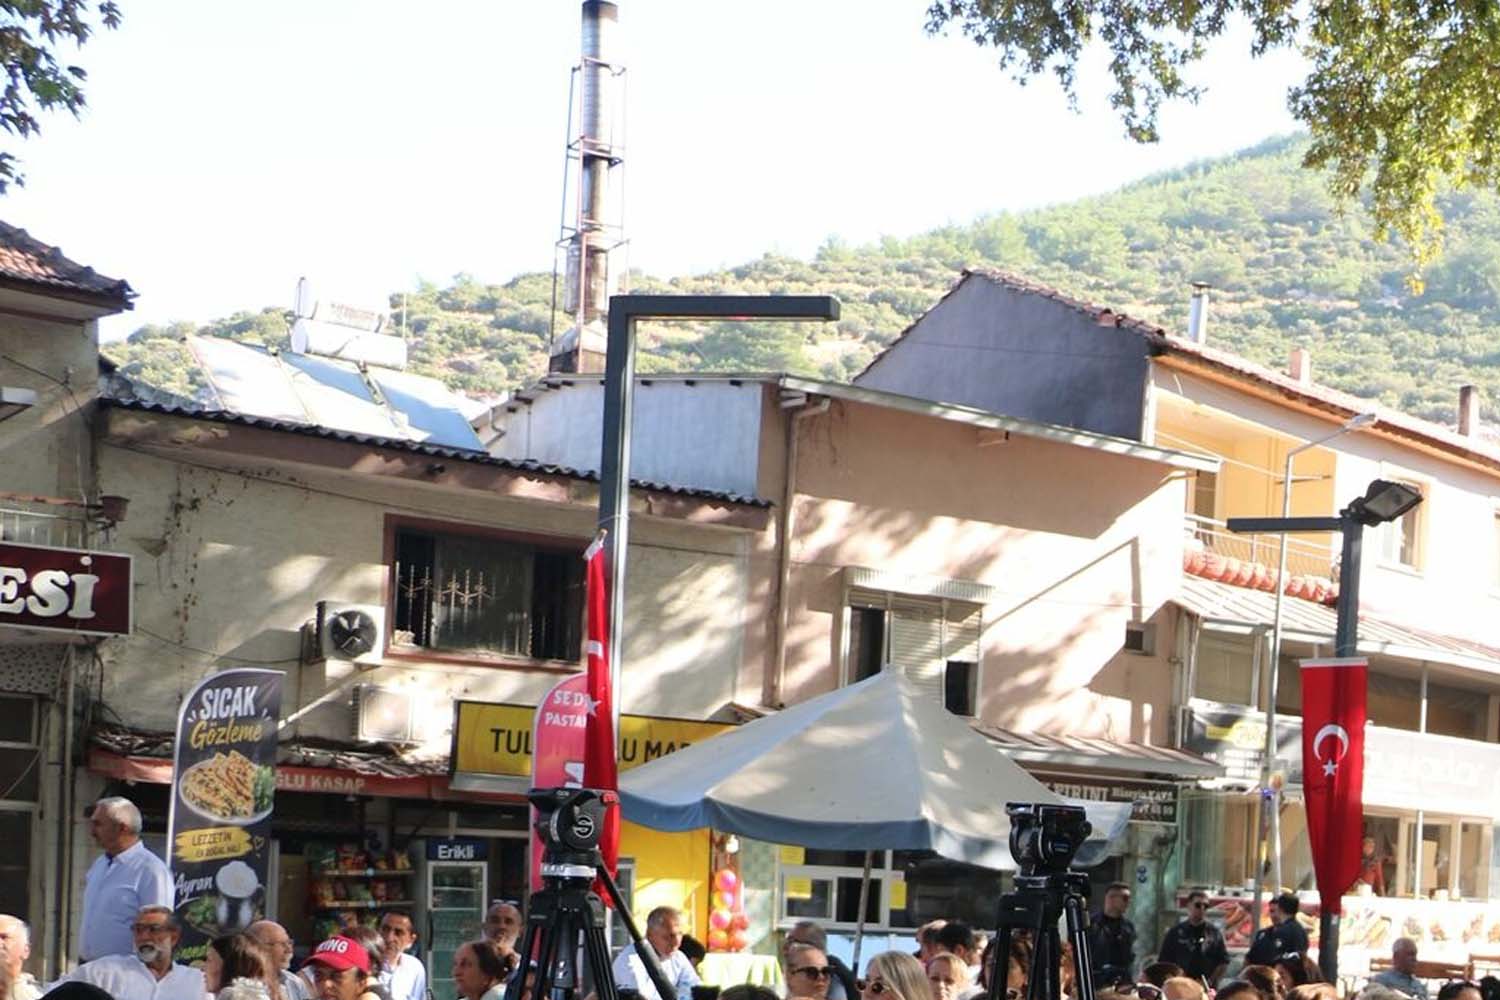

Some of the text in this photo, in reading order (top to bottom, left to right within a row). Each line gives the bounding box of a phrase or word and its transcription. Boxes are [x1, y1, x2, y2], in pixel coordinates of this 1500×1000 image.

[200, 686, 258, 720] SICAK
[191, 717, 263, 751] Gözleme
[312, 775, 366, 793] KASAP
[437, 844, 474, 859] Erikli
[174, 872, 213, 899] Ayran
